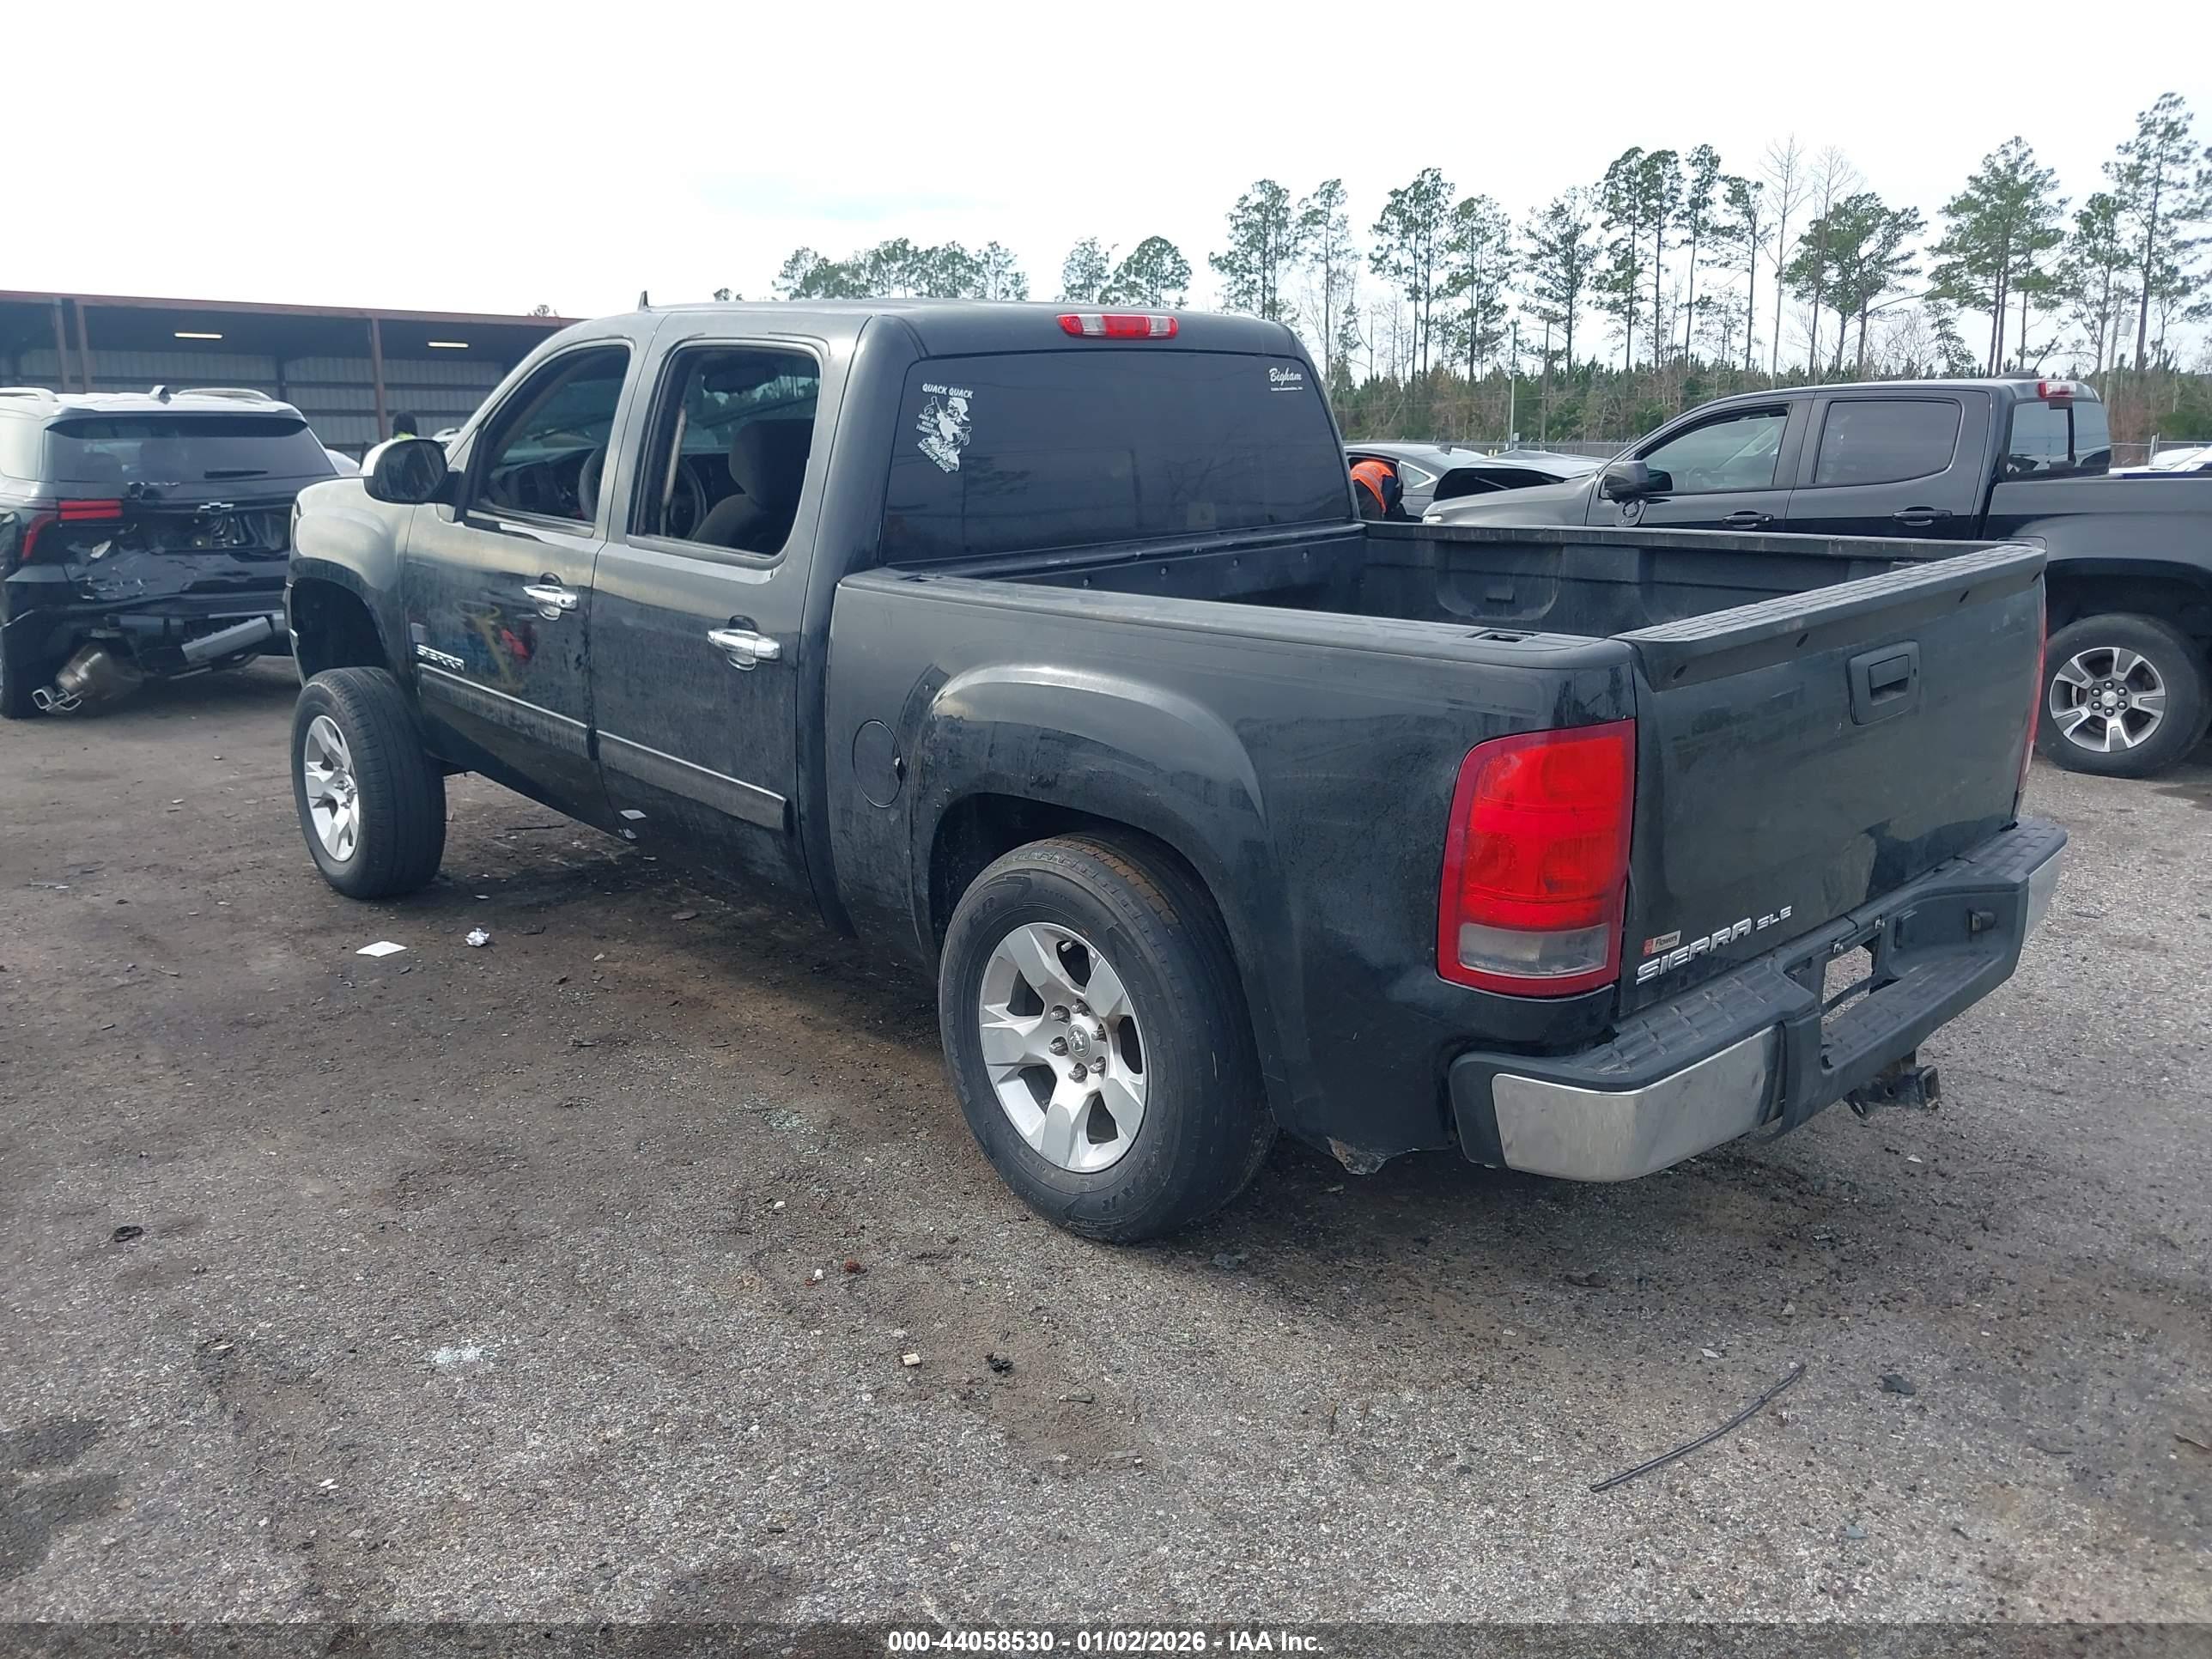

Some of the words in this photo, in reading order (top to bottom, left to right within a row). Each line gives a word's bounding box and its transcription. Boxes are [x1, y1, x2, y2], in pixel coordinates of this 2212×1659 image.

[1269, 367, 1302, 386] Bigham
[922, 383, 947, 395] QUACK
[949, 387, 973, 398] QUACK
[416, 644, 465, 672] SIERRA
[1636, 917, 1752, 986] SIERRA
[1756, 905, 1792, 932] SLE
